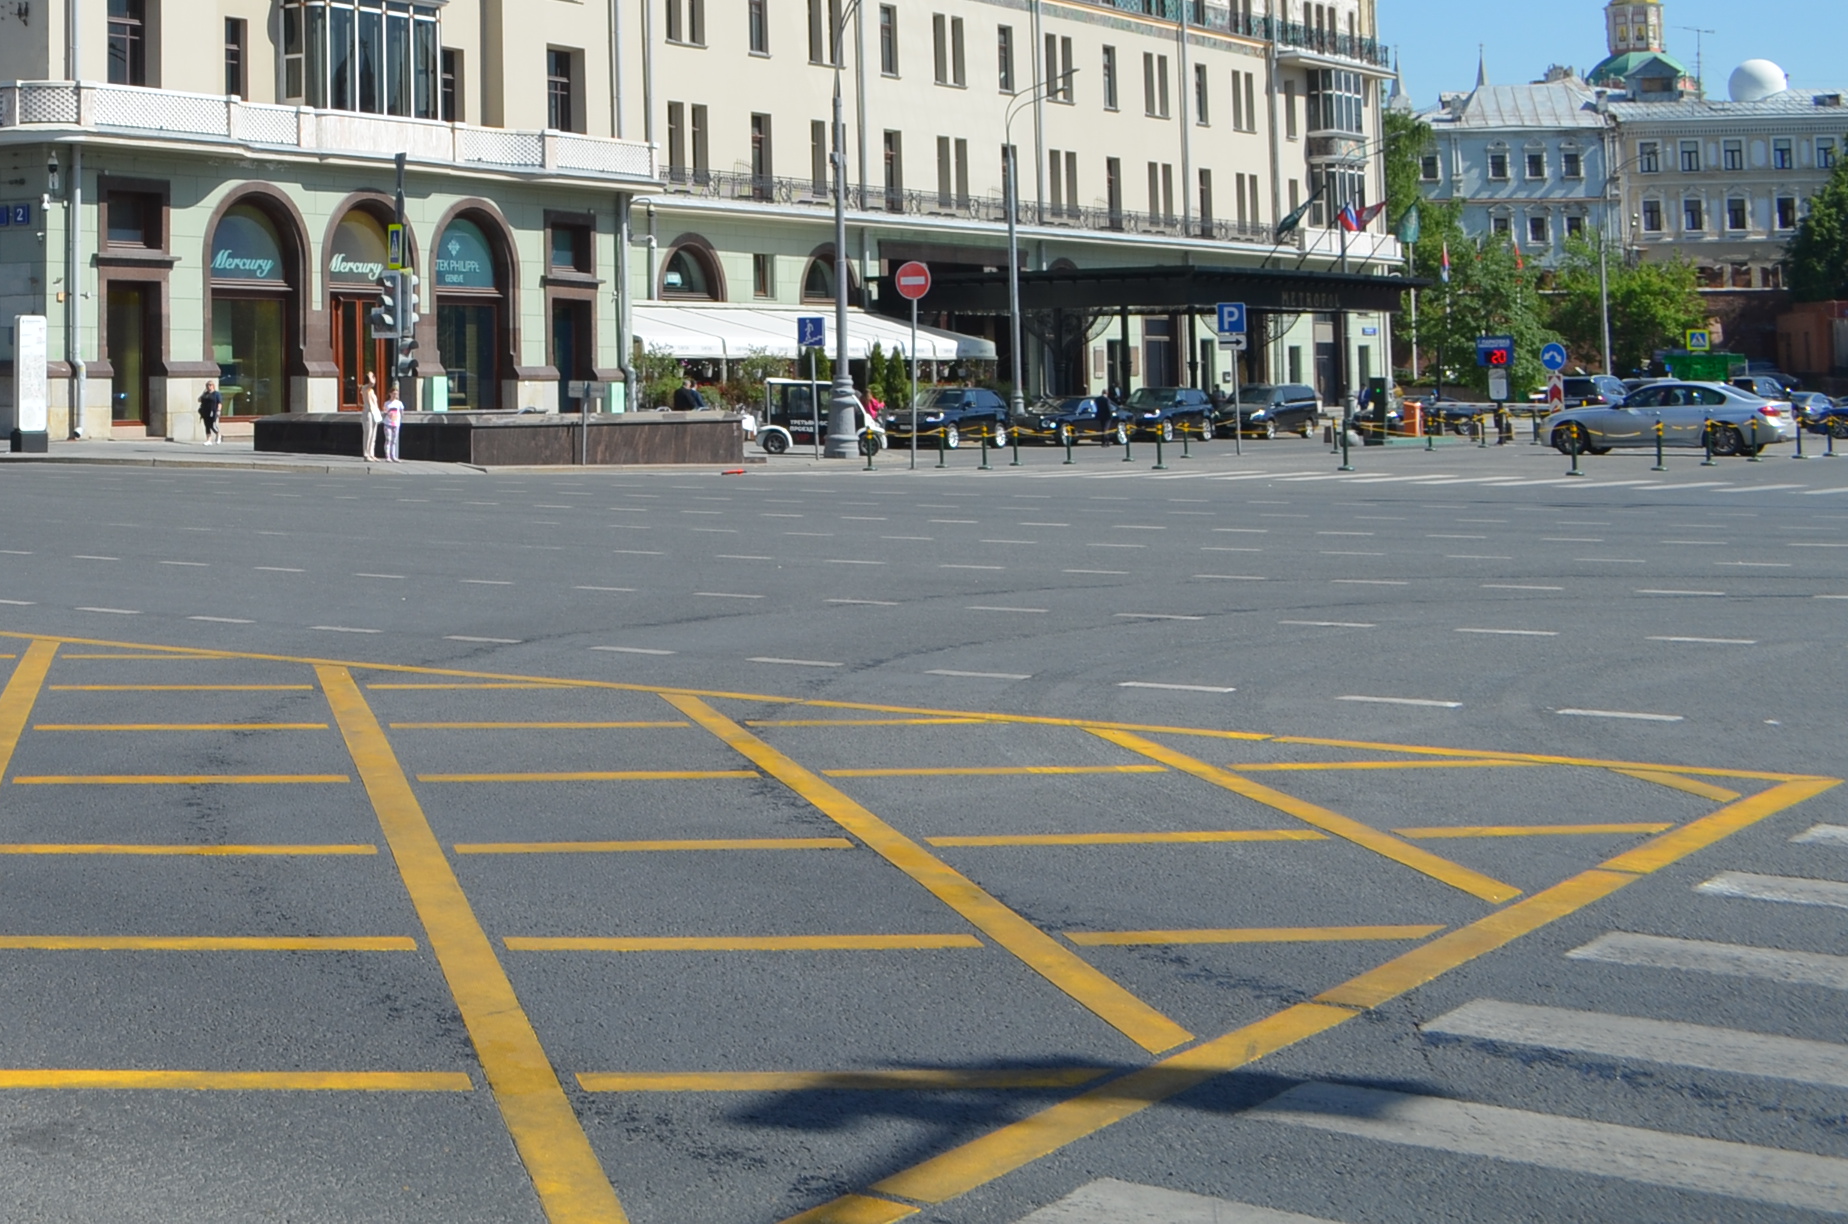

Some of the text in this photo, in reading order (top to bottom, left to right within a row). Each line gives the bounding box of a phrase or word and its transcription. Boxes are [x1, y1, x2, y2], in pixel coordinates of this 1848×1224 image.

[16, 208, 24, 221] 2
[210, 249, 273, 278] Mercury
[329, 253, 383, 280] Mercury
[435, 259, 450, 271] TEK
[1281, 291, 1341, 308] METROPOL
[1492, 349, 1507, 364] 20
